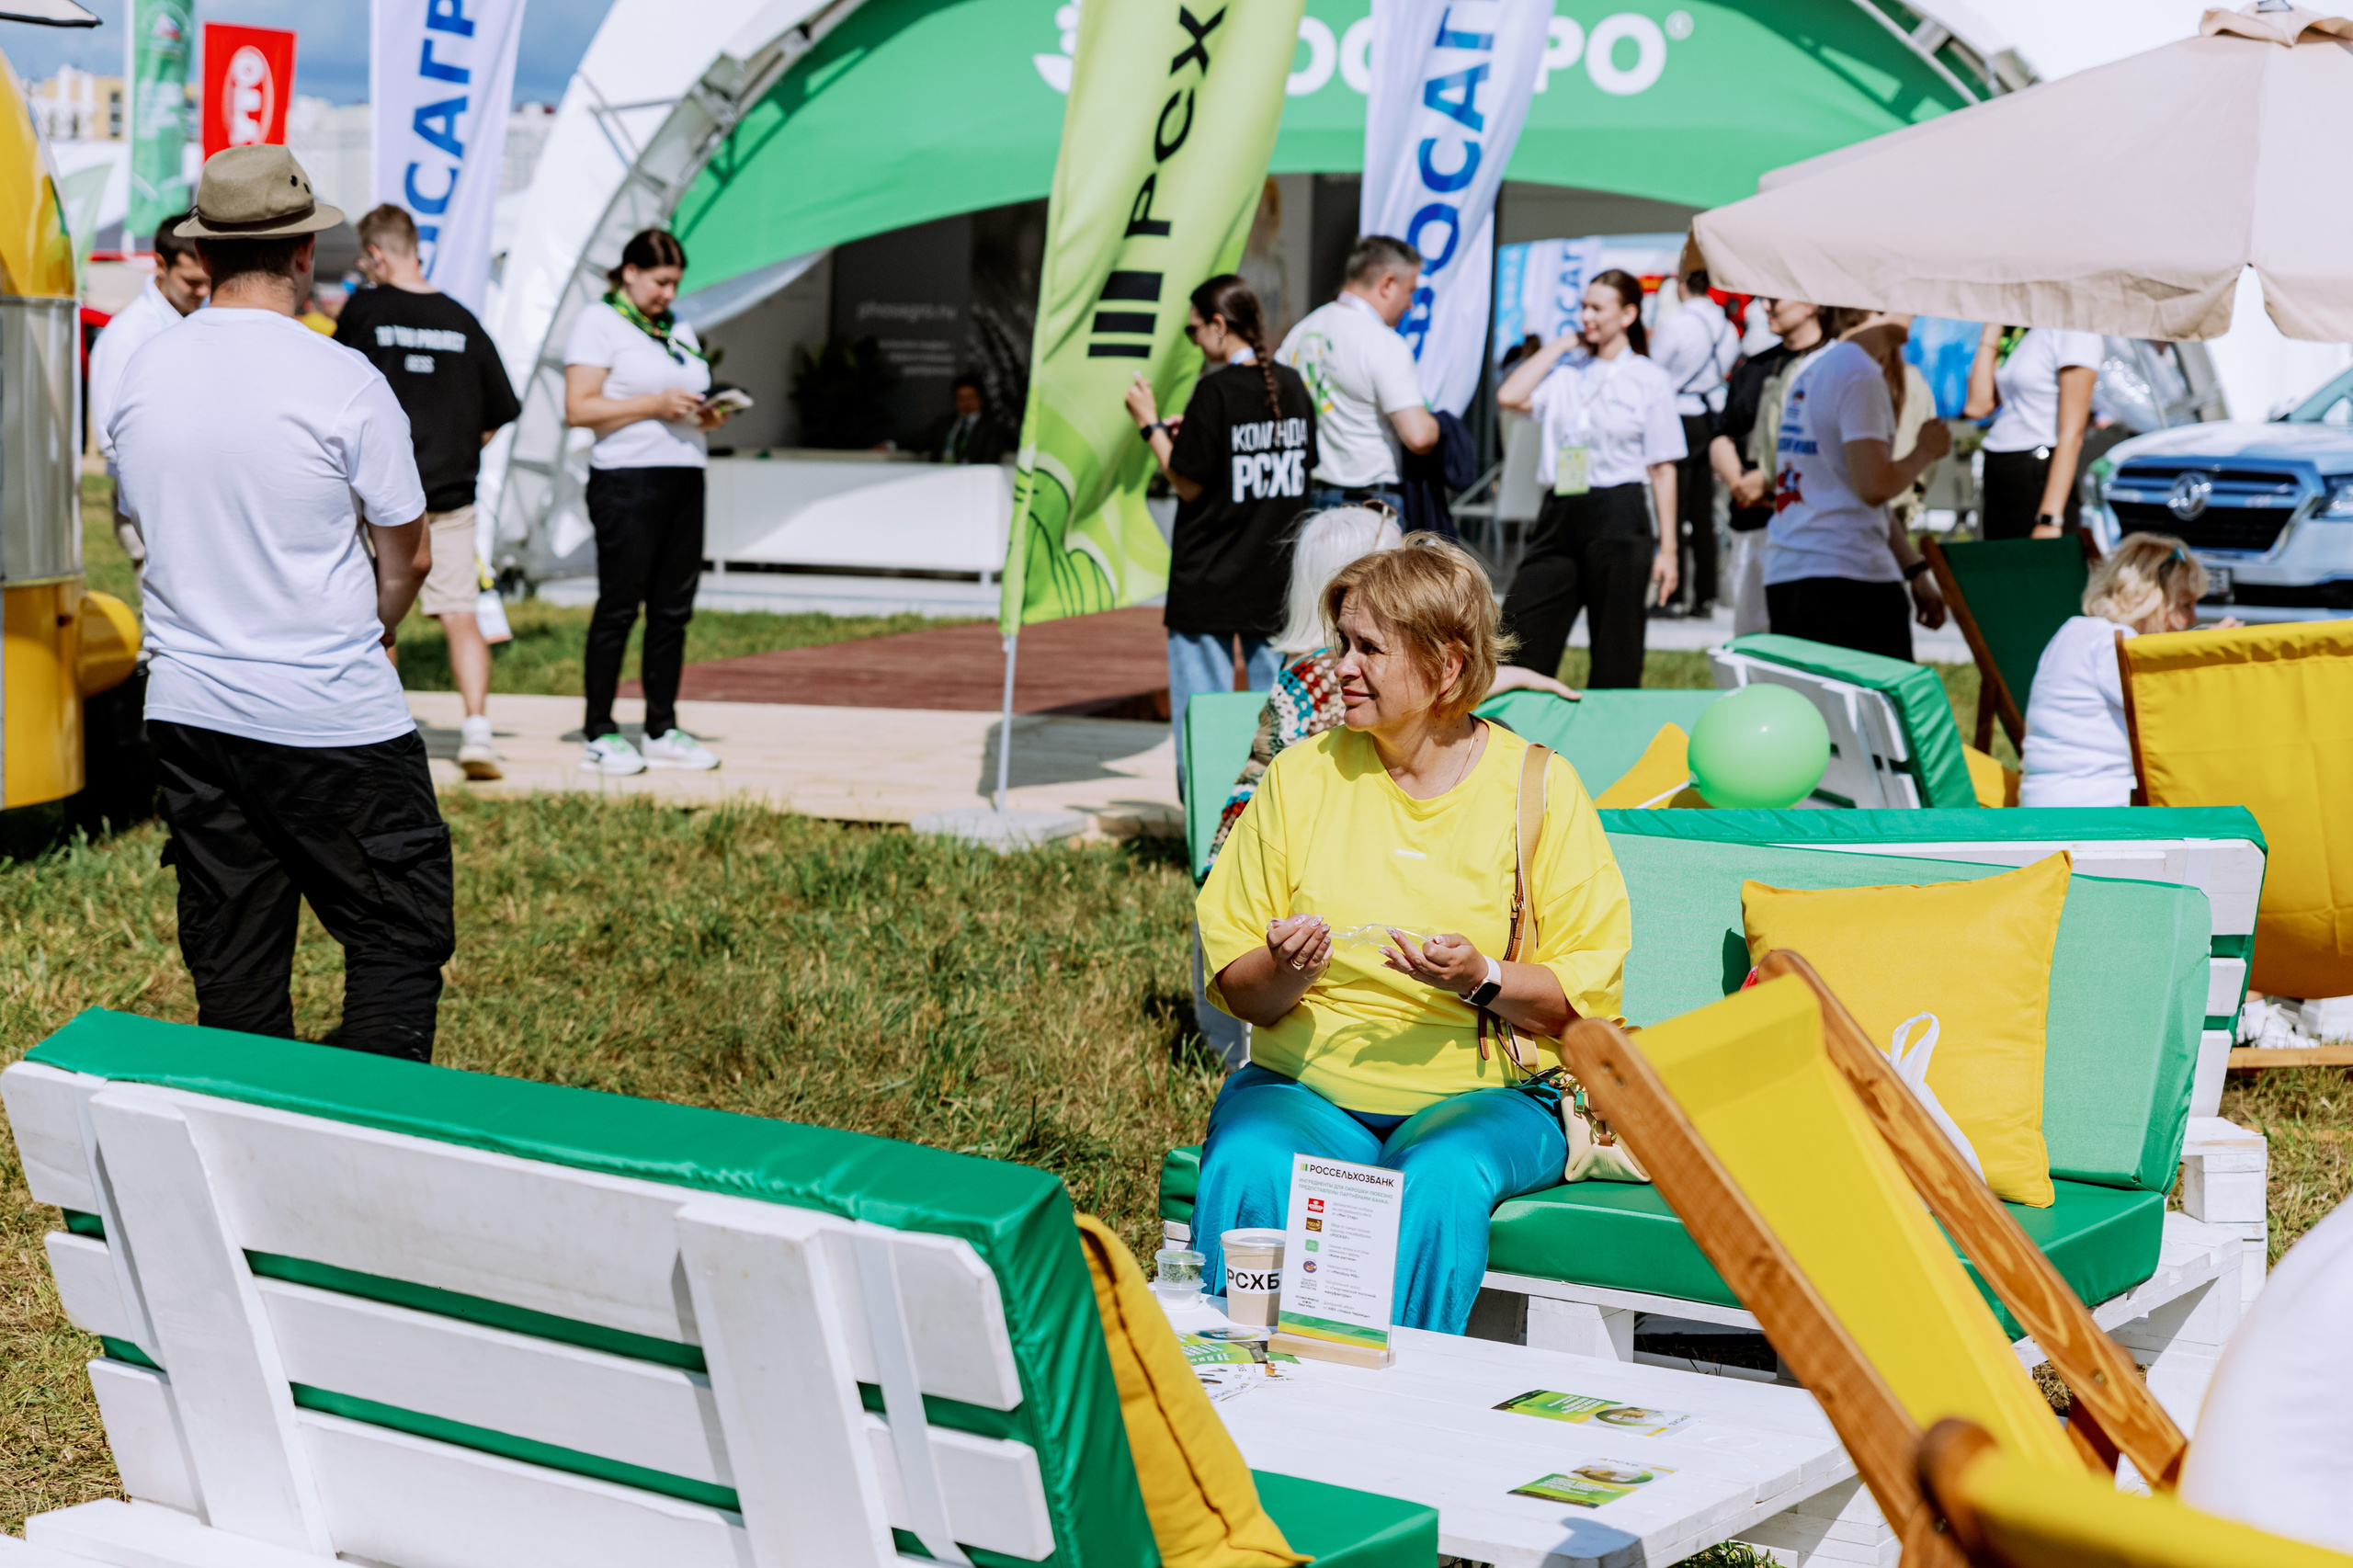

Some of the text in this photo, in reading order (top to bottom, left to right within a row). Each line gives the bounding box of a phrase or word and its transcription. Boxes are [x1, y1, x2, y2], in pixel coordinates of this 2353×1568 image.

[1122, 4, 1227, 240] РСХ
[1232, 449, 1306, 503] РСХБ
[1309, 1165, 1394, 1187] РОССЕЛЬХОЗБАНК
[1227, 1267, 1280, 1290] РСХБ
